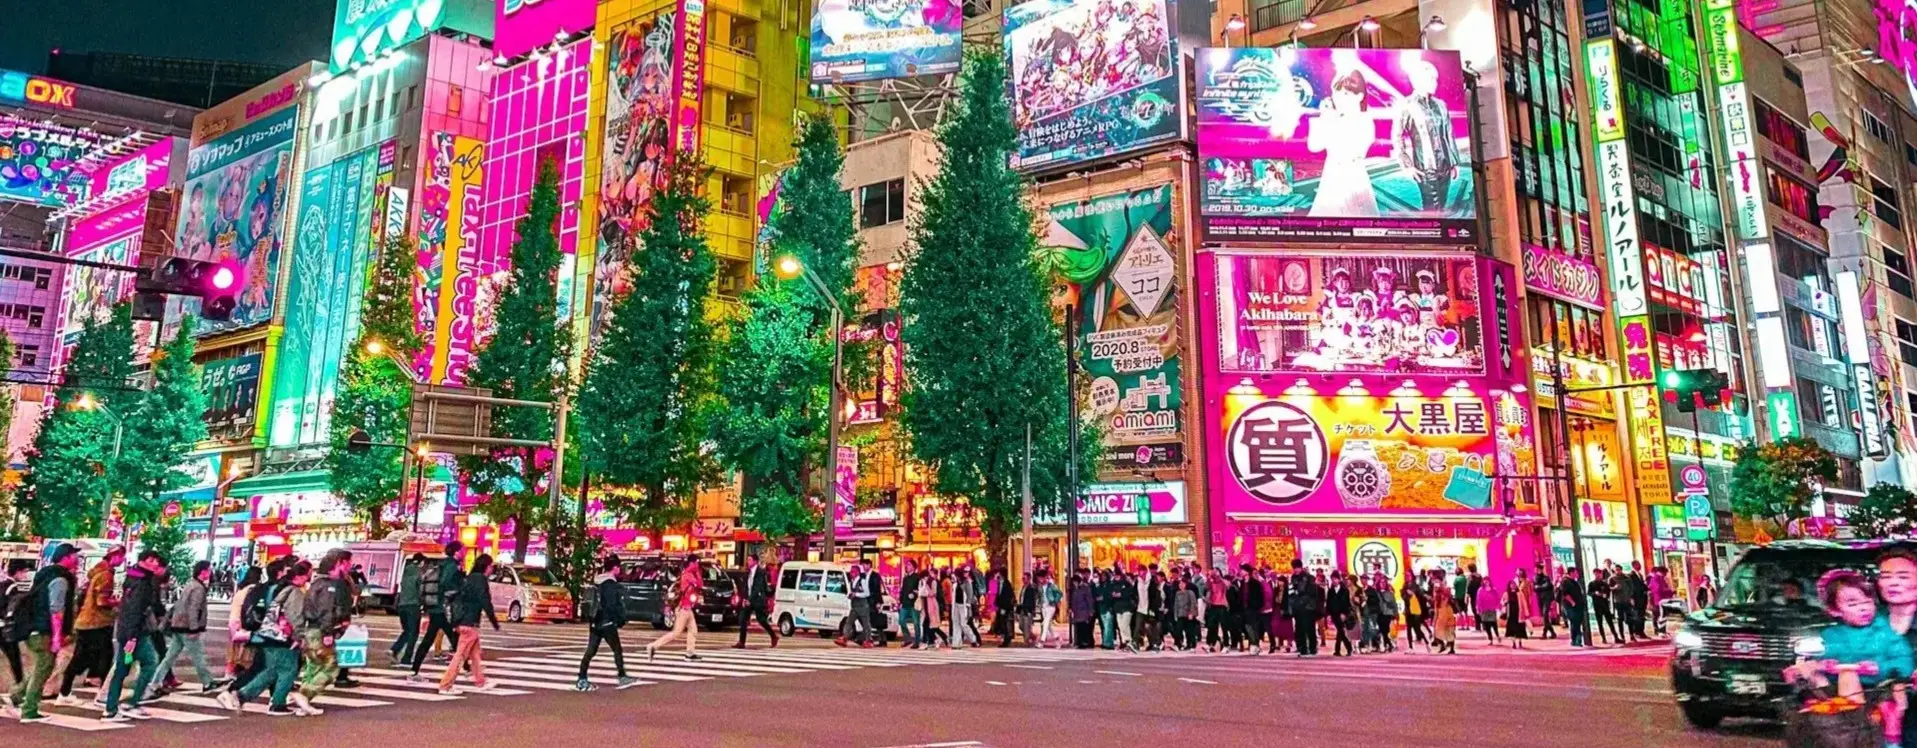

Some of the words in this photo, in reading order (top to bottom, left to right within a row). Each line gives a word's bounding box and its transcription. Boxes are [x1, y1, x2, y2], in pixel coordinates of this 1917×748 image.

[200, 134, 244, 167] ソフマップ
[1128, 253, 1164, 268] アトリエ
[1131, 276, 1160, 296] ココ
[1248, 291, 1272, 305] We
[1273, 292, 1309, 305] Love
[1240, 308, 1319, 321] Akihabara
[1093, 341, 1139, 357] 2020.8
[1113, 356, 1162, 371] 予約受付中
[1382, 402, 1488, 435] 大黒屋
[1855, 365, 1882, 454] GALLERIA
[1113, 411, 1176, 429] amiami
[1334, 424, 1376, 435] チケット
[1240, 416, 1320, 491] 質
[1649, 425, 1666, 470] FREE
[1597, 443, 1612, 491] ルノアール
[1687, 471, 1701, 481] 40
[1075, 495, 1118, 513] OMIC
[693, 519, 729, 537] ラーメン
